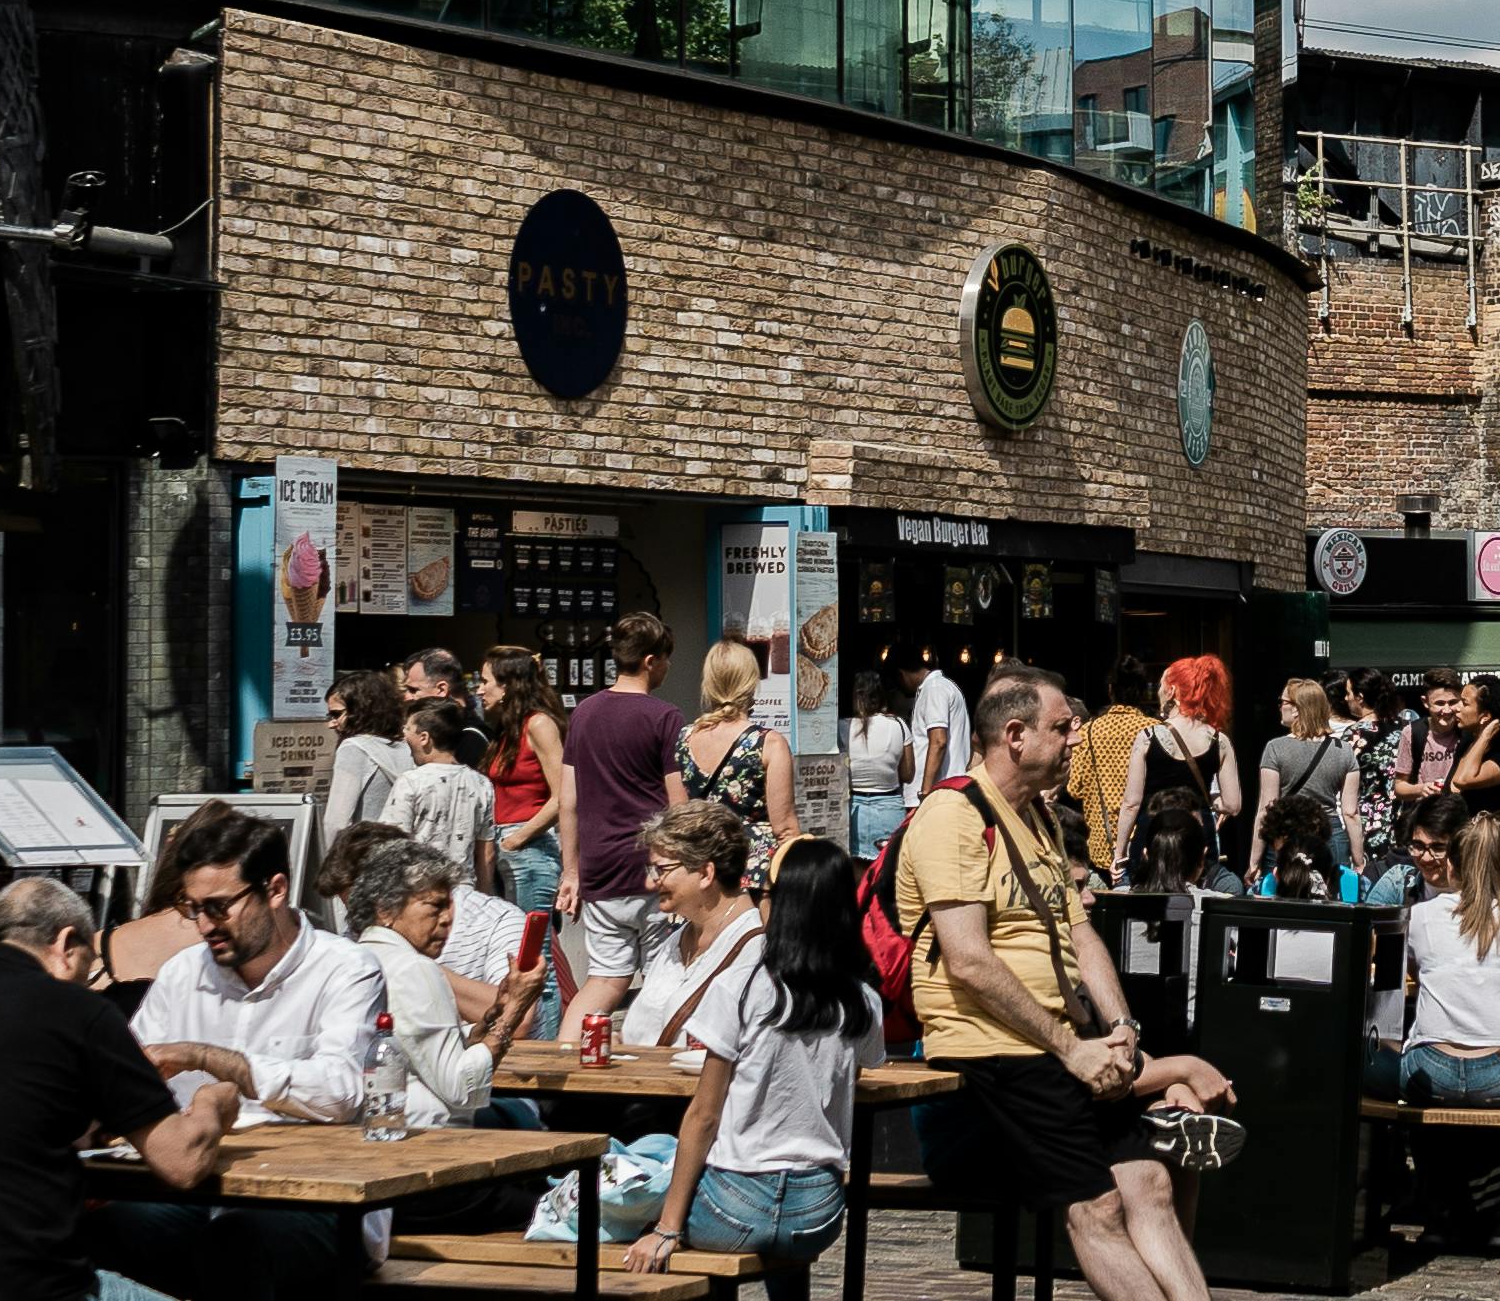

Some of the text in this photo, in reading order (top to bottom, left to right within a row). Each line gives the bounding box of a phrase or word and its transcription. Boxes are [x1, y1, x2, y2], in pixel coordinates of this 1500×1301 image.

[516, 261, 620, 306] PASTY
[279, 479, 334, 505] ICE CREAM
[543, 516, 588, 532] PASTIES
[897, 515, 990, 547] Vegan Burger Bar
[1325, 532, 1364, 554] MEXICAN
[725, 546, 787, 559] FRESHLY
[726, 562, 786, 574] BREWED
[1331, 580, 1358, 592] GRILL
[271, 736, 325, 748] ICED COLD
[280, 750, 317, 761] DRINKS
[816, 765, 836, 775] COLD
